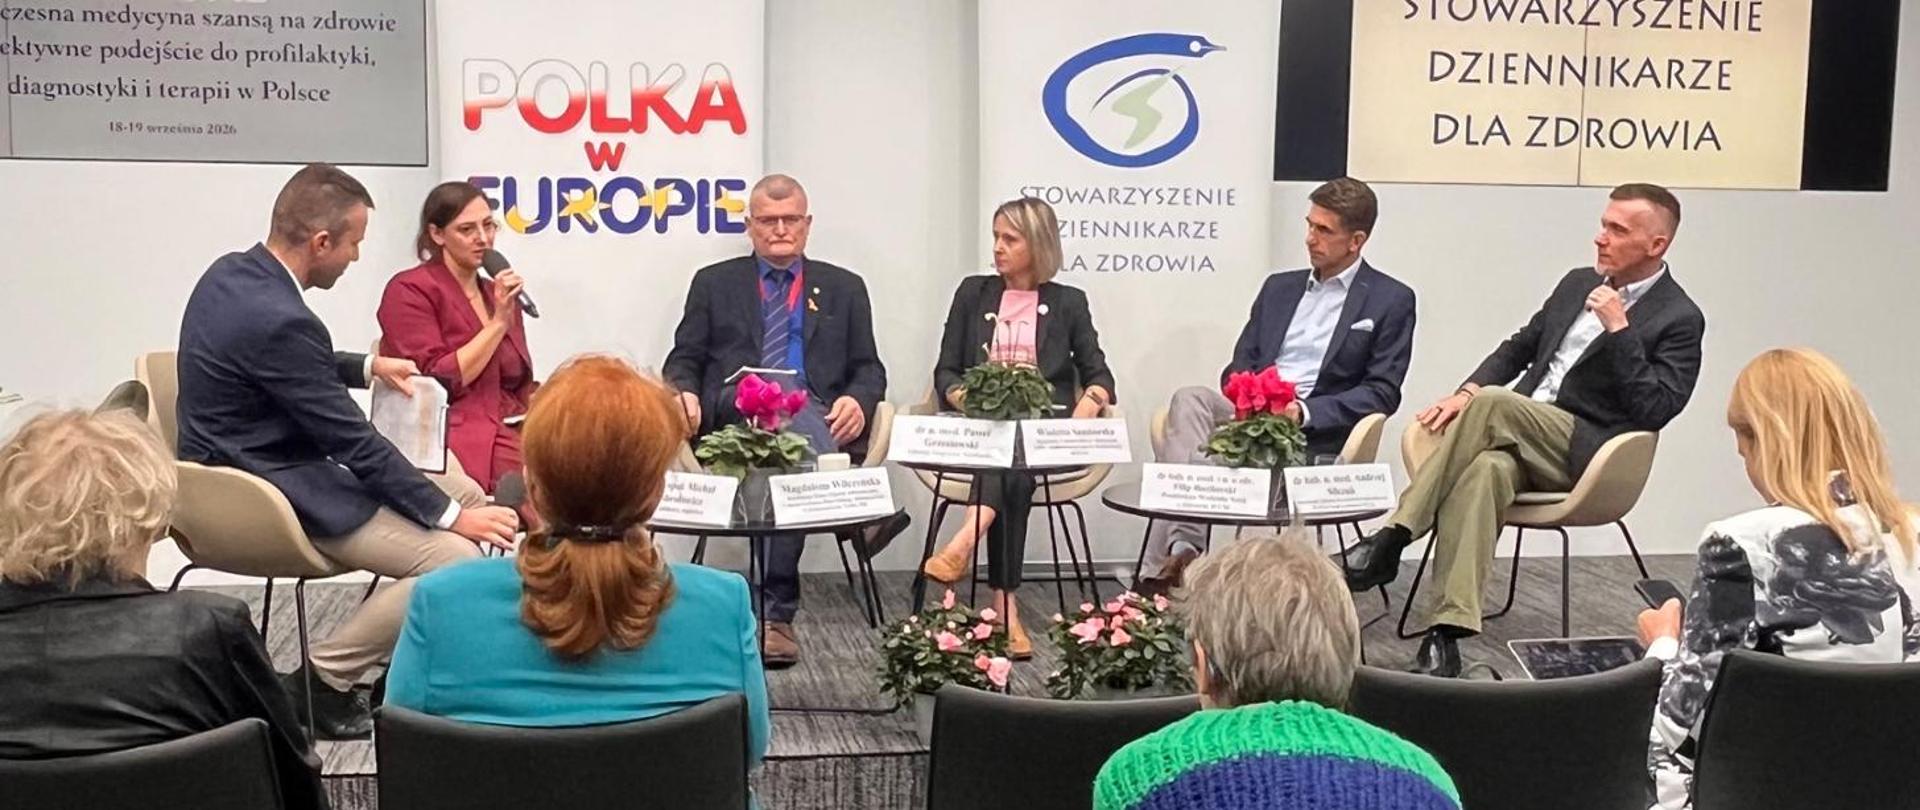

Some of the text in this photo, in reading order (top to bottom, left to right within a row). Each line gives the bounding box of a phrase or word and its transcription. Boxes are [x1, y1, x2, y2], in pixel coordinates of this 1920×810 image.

[82, 4, 196, 31] medycyna
[202, 13, 274, 33] szansą
[280, 15, 306, 29] na
[312, 10, 398, 32] zdrowie
[1404, 0, 1763, 32] STOWARZYSZENIE
[100, 39, 204, 65] podejście
[211, 41, 238, 61] do
[246, 43, 376, 70] profilaktyki,
[1428, 50, 1733, 91] DZIENNIKARZE
[8, 74, 331, 104] diagnostyki i terapii w Polsce
[462, 58, 747, 135] POLKA
[109, 121, 143, 133] 18-19
[1433, 113, 1722, 152] DLA ZDROWIA
[1020, 186, 1236, 206] STOWARZYSZENIE
[1058, 220, 1219, 239] ZIENNIKARZE
[1096, 254, 1215, 272] ZDROWIA
